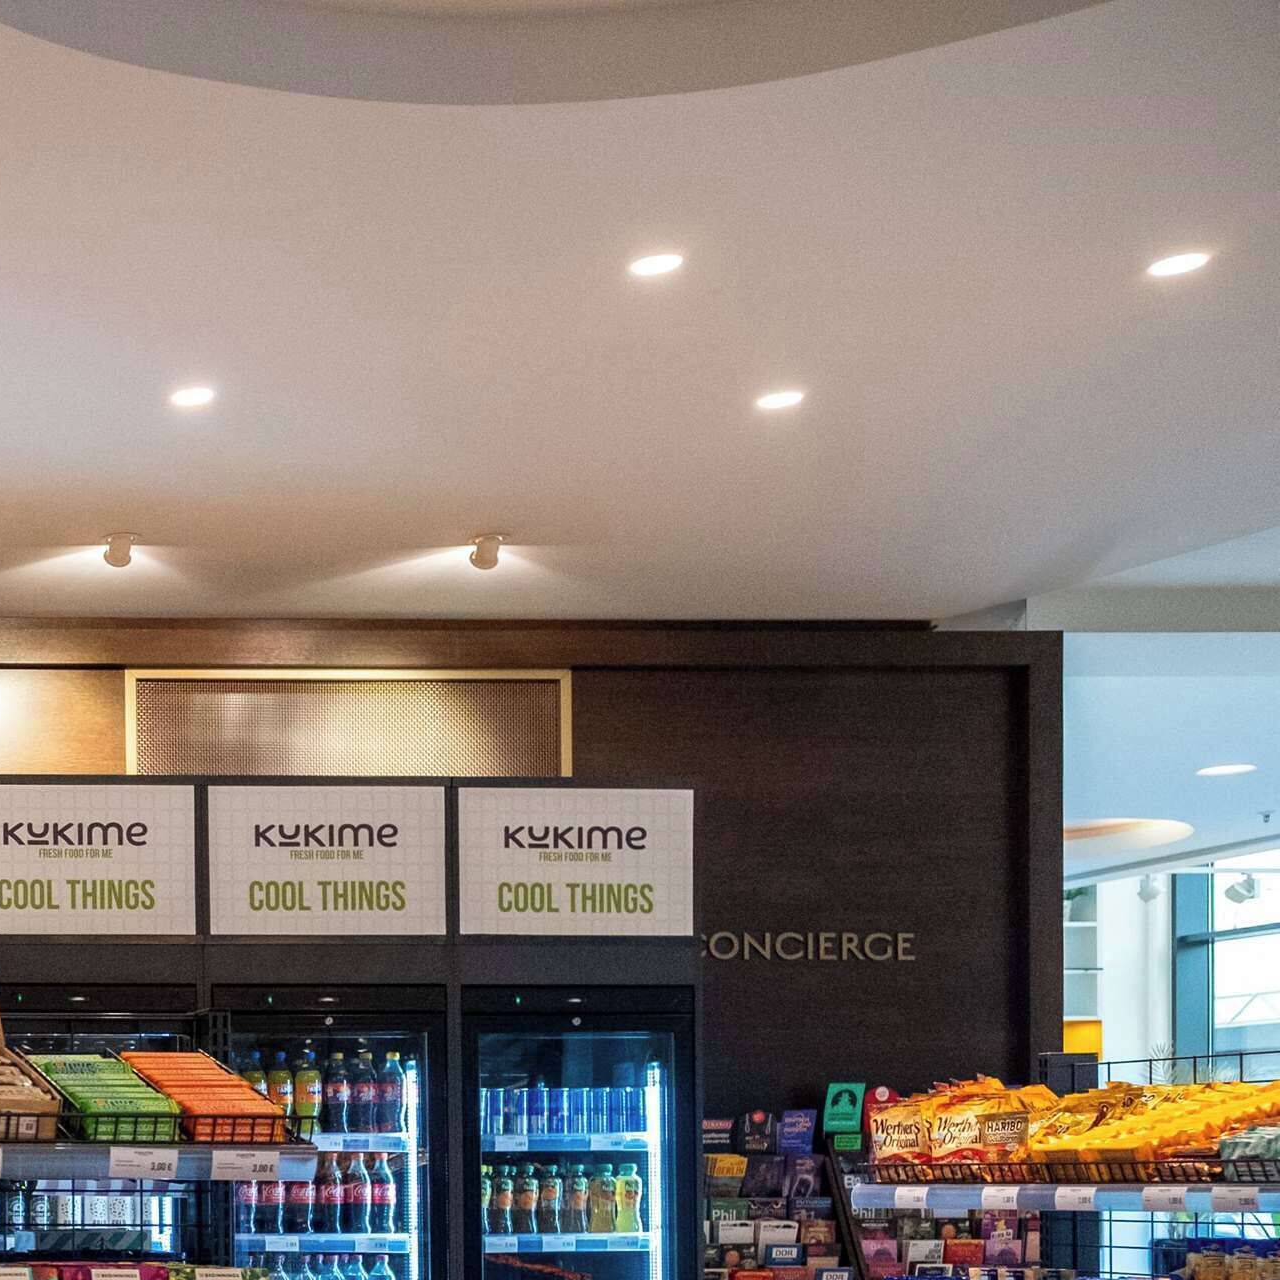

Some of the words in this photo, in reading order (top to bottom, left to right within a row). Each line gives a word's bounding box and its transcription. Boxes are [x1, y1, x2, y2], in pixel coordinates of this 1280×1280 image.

[38, 847, 63, 859] FRESH
[64, 847, 84, 859] FOOD
[85, 847, 100, 859] FOR
[101, 847, 113, 859] ME
[289, 849, 314, 860] FRESH
[315, 849, 335, 860] FOOD
[336, 849, 351, 860] FOR
[352, 849, 364, 860] ME
[539, 851, 563, 862] FRESH
[564, 851, 584, 862] FOOD
[585, 851, 600, 862] FOR
[601, 851, 612, 862] ME
[67, 879, 156, 911] THINGS
[249, 880, 310, 911] COOL
[318, 880, 406, 912] THINGS
[498, 882, 559, 913] COOL
[566, 882, 654, 914] THINGS
[701, 931, 916, 961] ONCIERGE
[986, 1119, 1023, 1133] HARIBO
